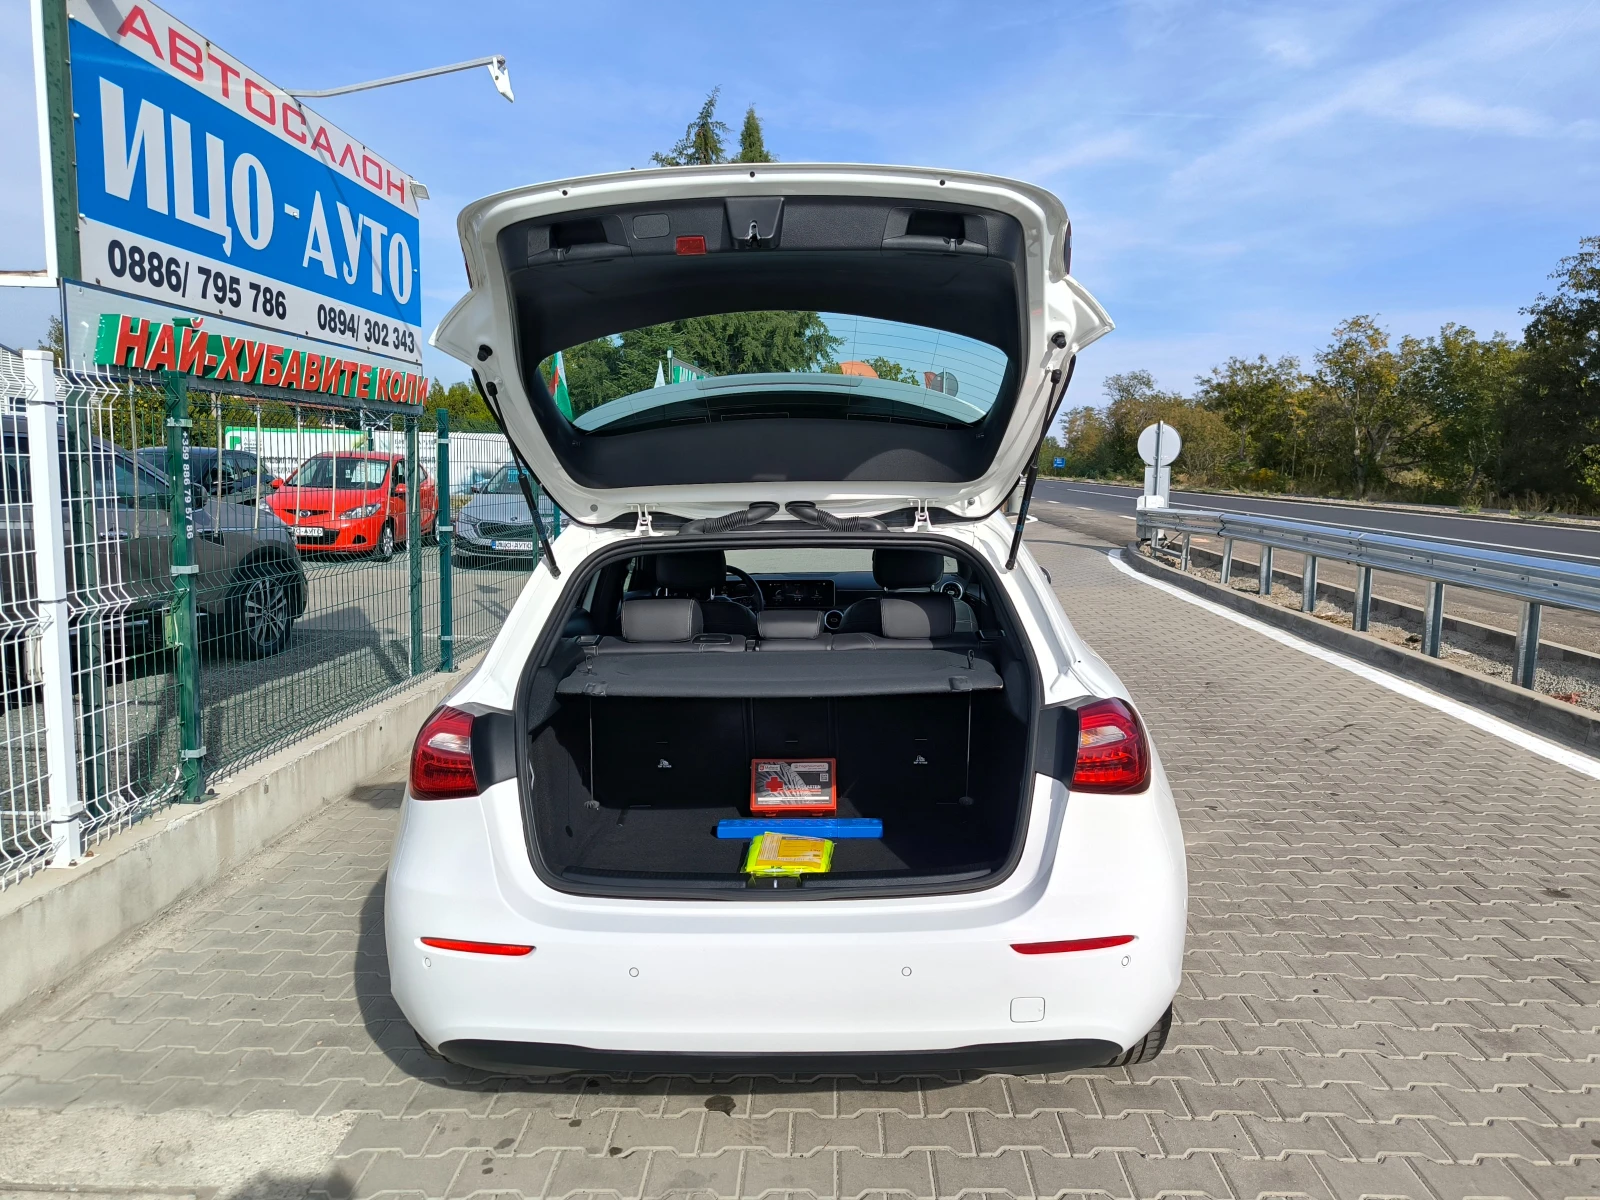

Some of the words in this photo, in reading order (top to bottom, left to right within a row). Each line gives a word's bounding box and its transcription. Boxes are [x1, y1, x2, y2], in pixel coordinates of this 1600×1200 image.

[117, 4, 405, 205] АВТОСАЛОН
[108, 239, 190, 298] 0886/
[198, 266, 242, 308] 795
[249, 283, 287, 320] 786
[317, 304, 360, 342] 0894/
[364, 318, 389, 347] 302
[392, 330, 415, 354] 343
[113, 315, 373, 399] НАЙ-ХУБАВИТЕ
[376, 366, 429, 406] КОЛИ
[182, 431, 190, 460] +359
[183, 463, 191, 485] 886
[184, 489, 192, 504] 79
[186, 525, 194, 539] 86
